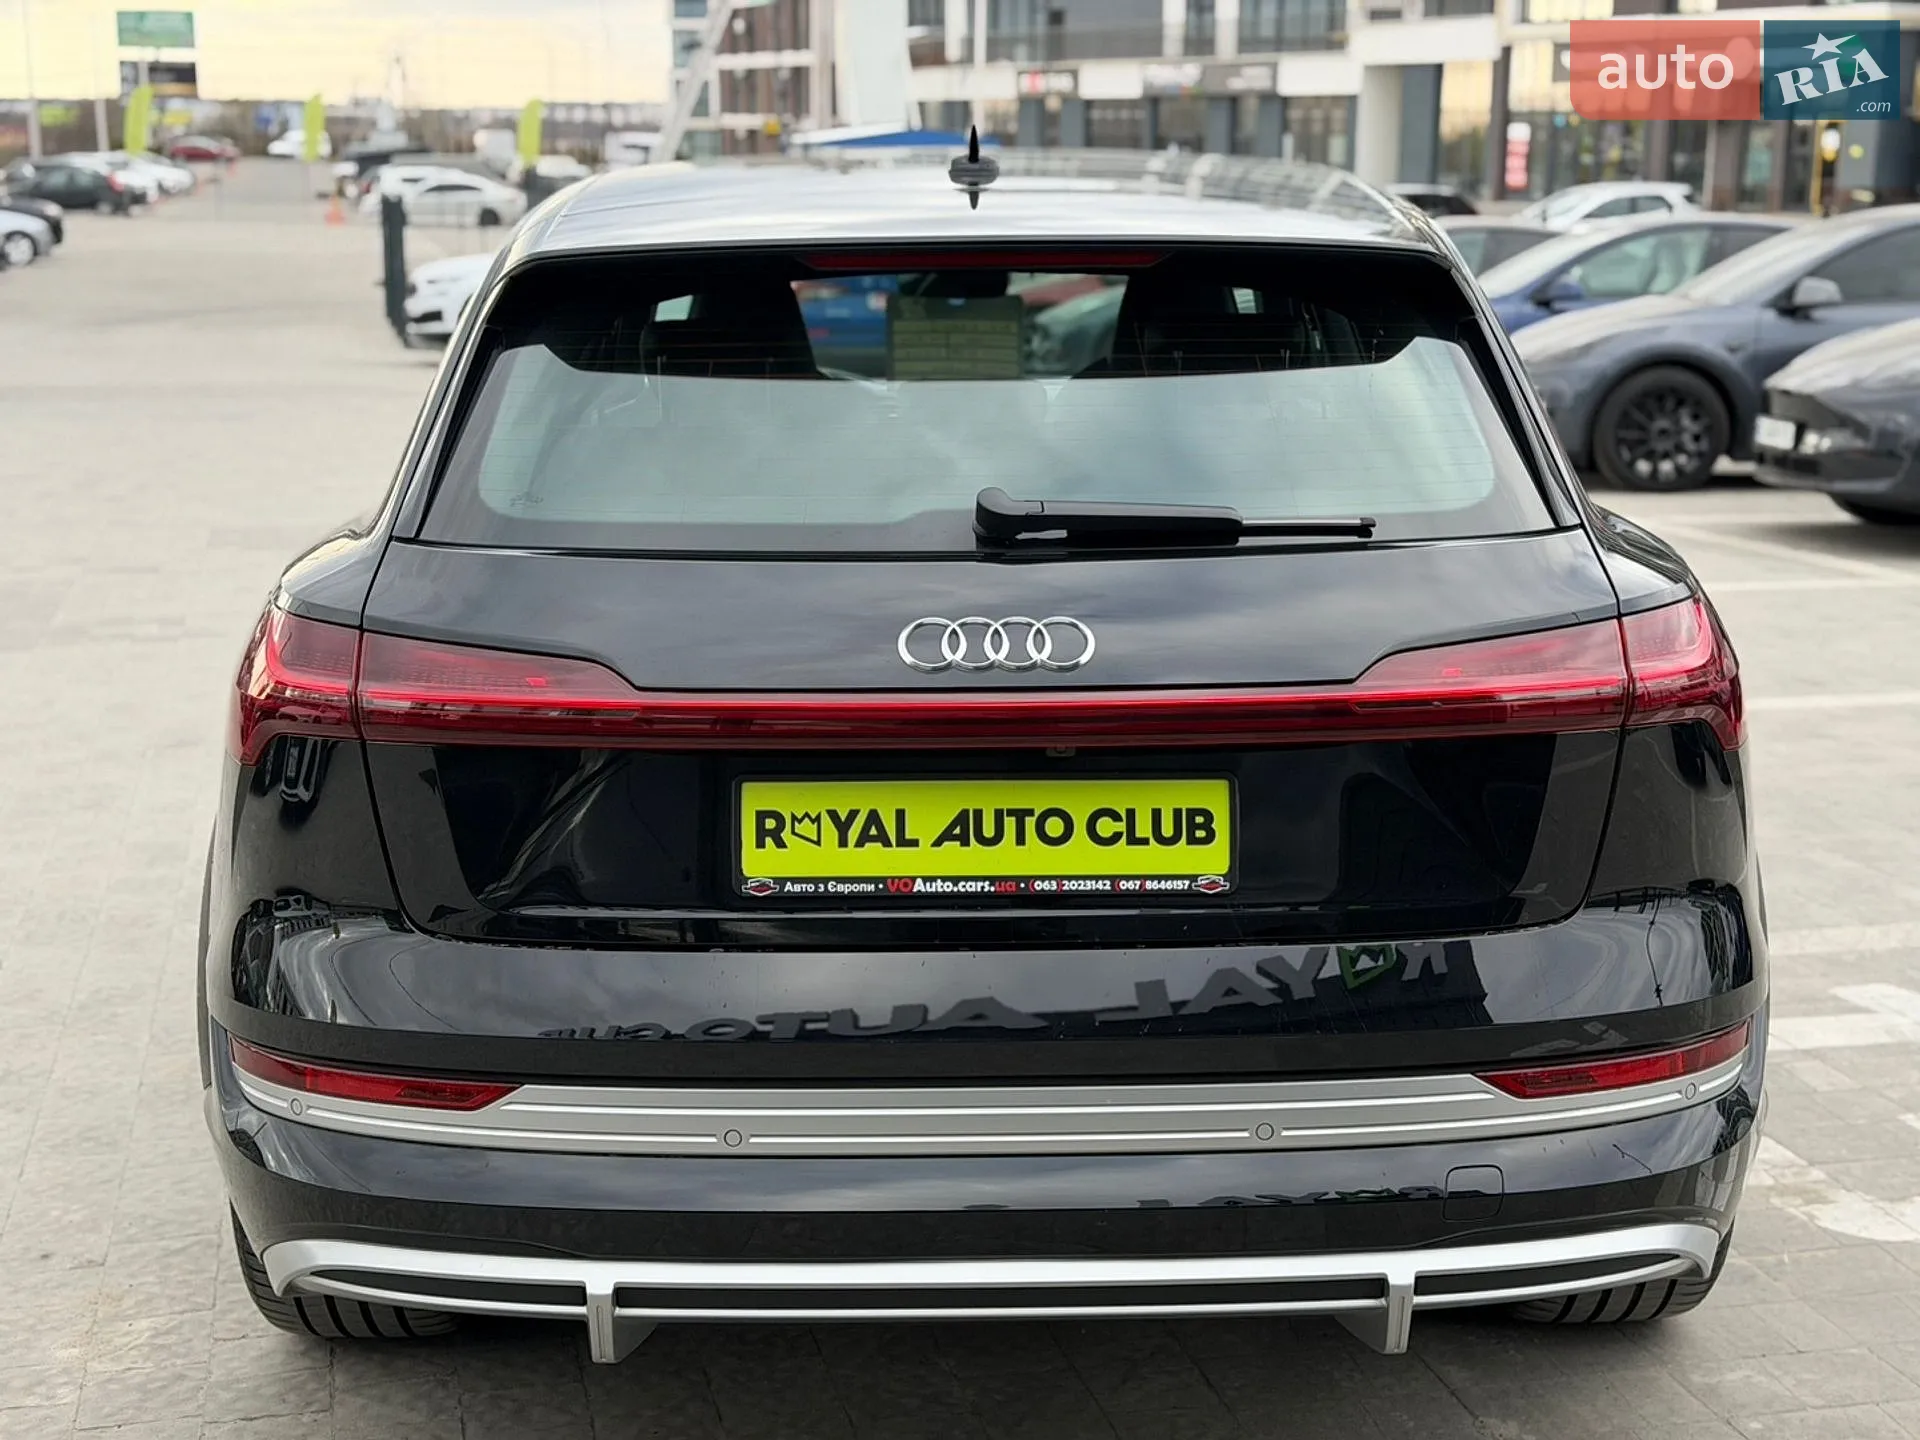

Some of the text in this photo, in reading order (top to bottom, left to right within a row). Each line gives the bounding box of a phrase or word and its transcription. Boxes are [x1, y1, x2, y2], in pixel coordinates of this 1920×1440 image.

[931, 808, 1074, 848] AUTO
[1085, 807, 1217, 847] CLUB
[784, 881, 814, 893] Авто
[827, 881, 875, 895] Європи
[887, 878, 1016, 893] VOAuto.cars.ua
